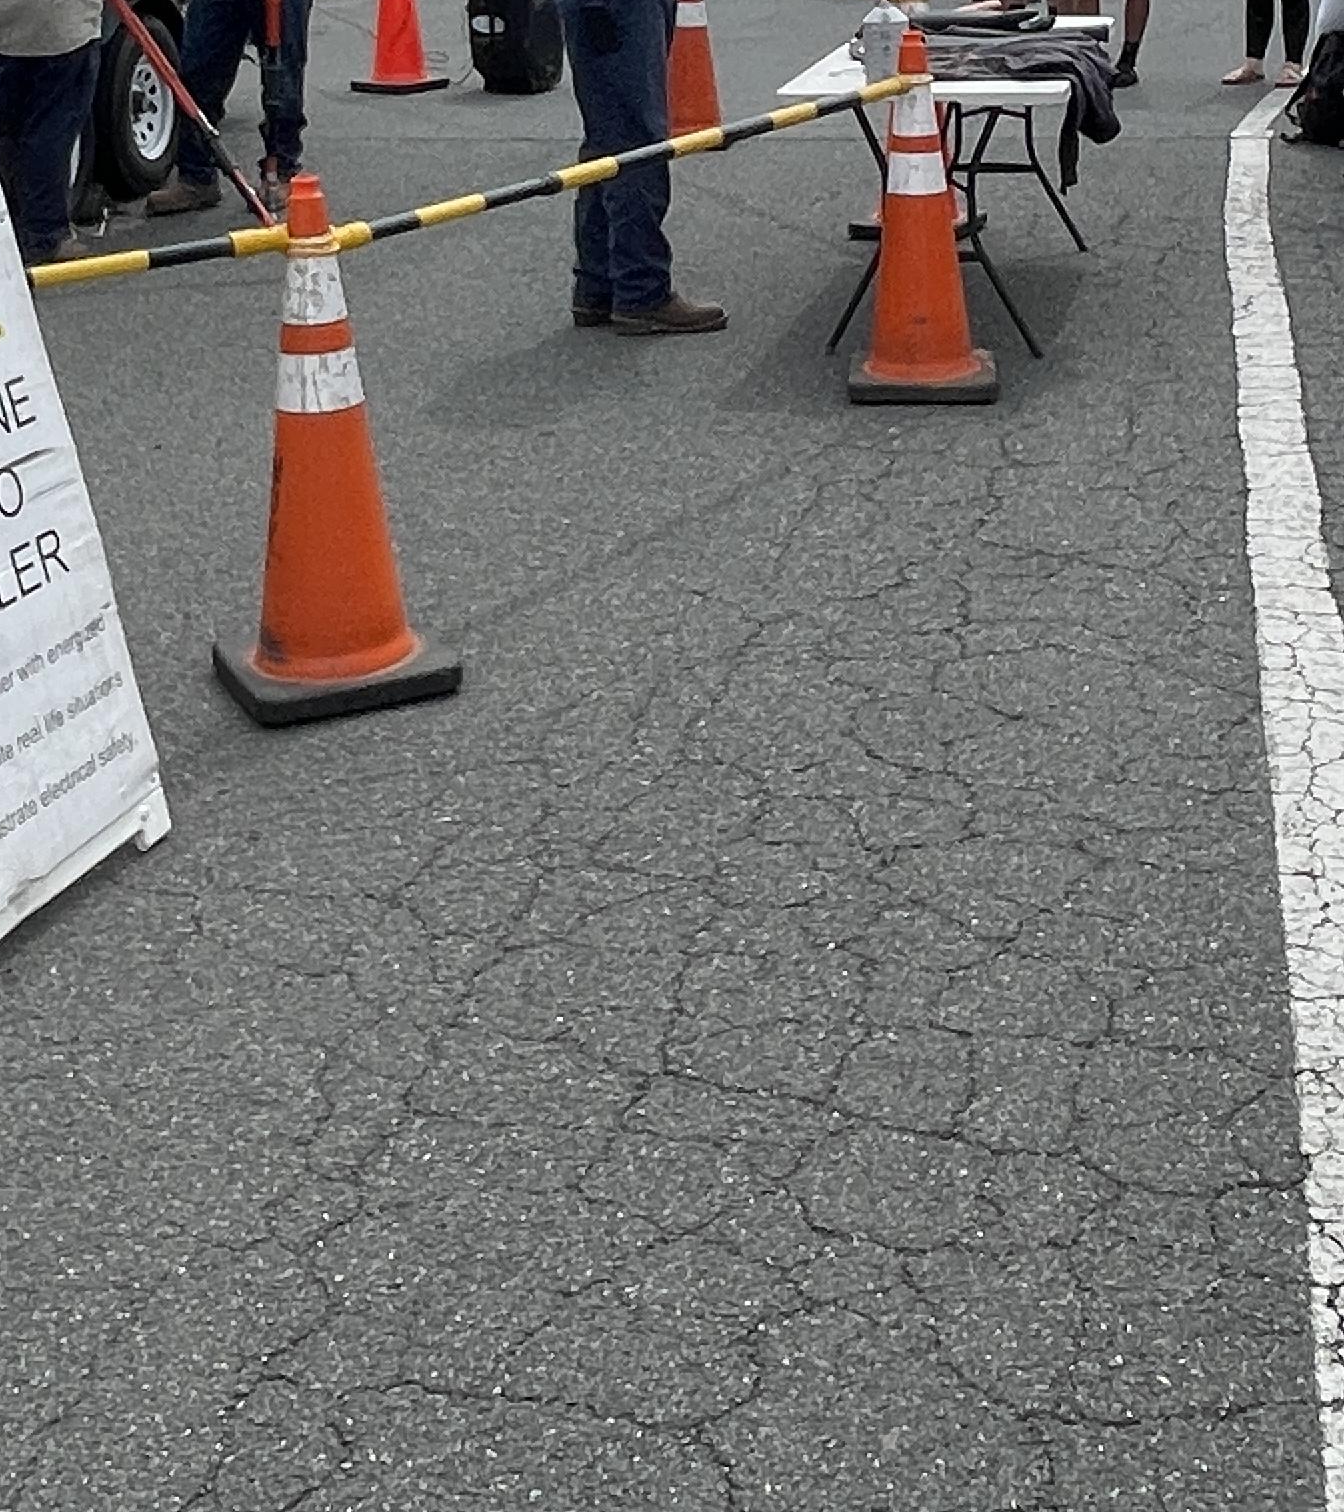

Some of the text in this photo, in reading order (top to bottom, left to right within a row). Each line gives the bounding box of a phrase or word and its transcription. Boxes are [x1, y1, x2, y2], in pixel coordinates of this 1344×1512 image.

[16, 653, 47, 682] with
[46, 615, 106, 664] energized
[39, 752, 97, 809] electrical
